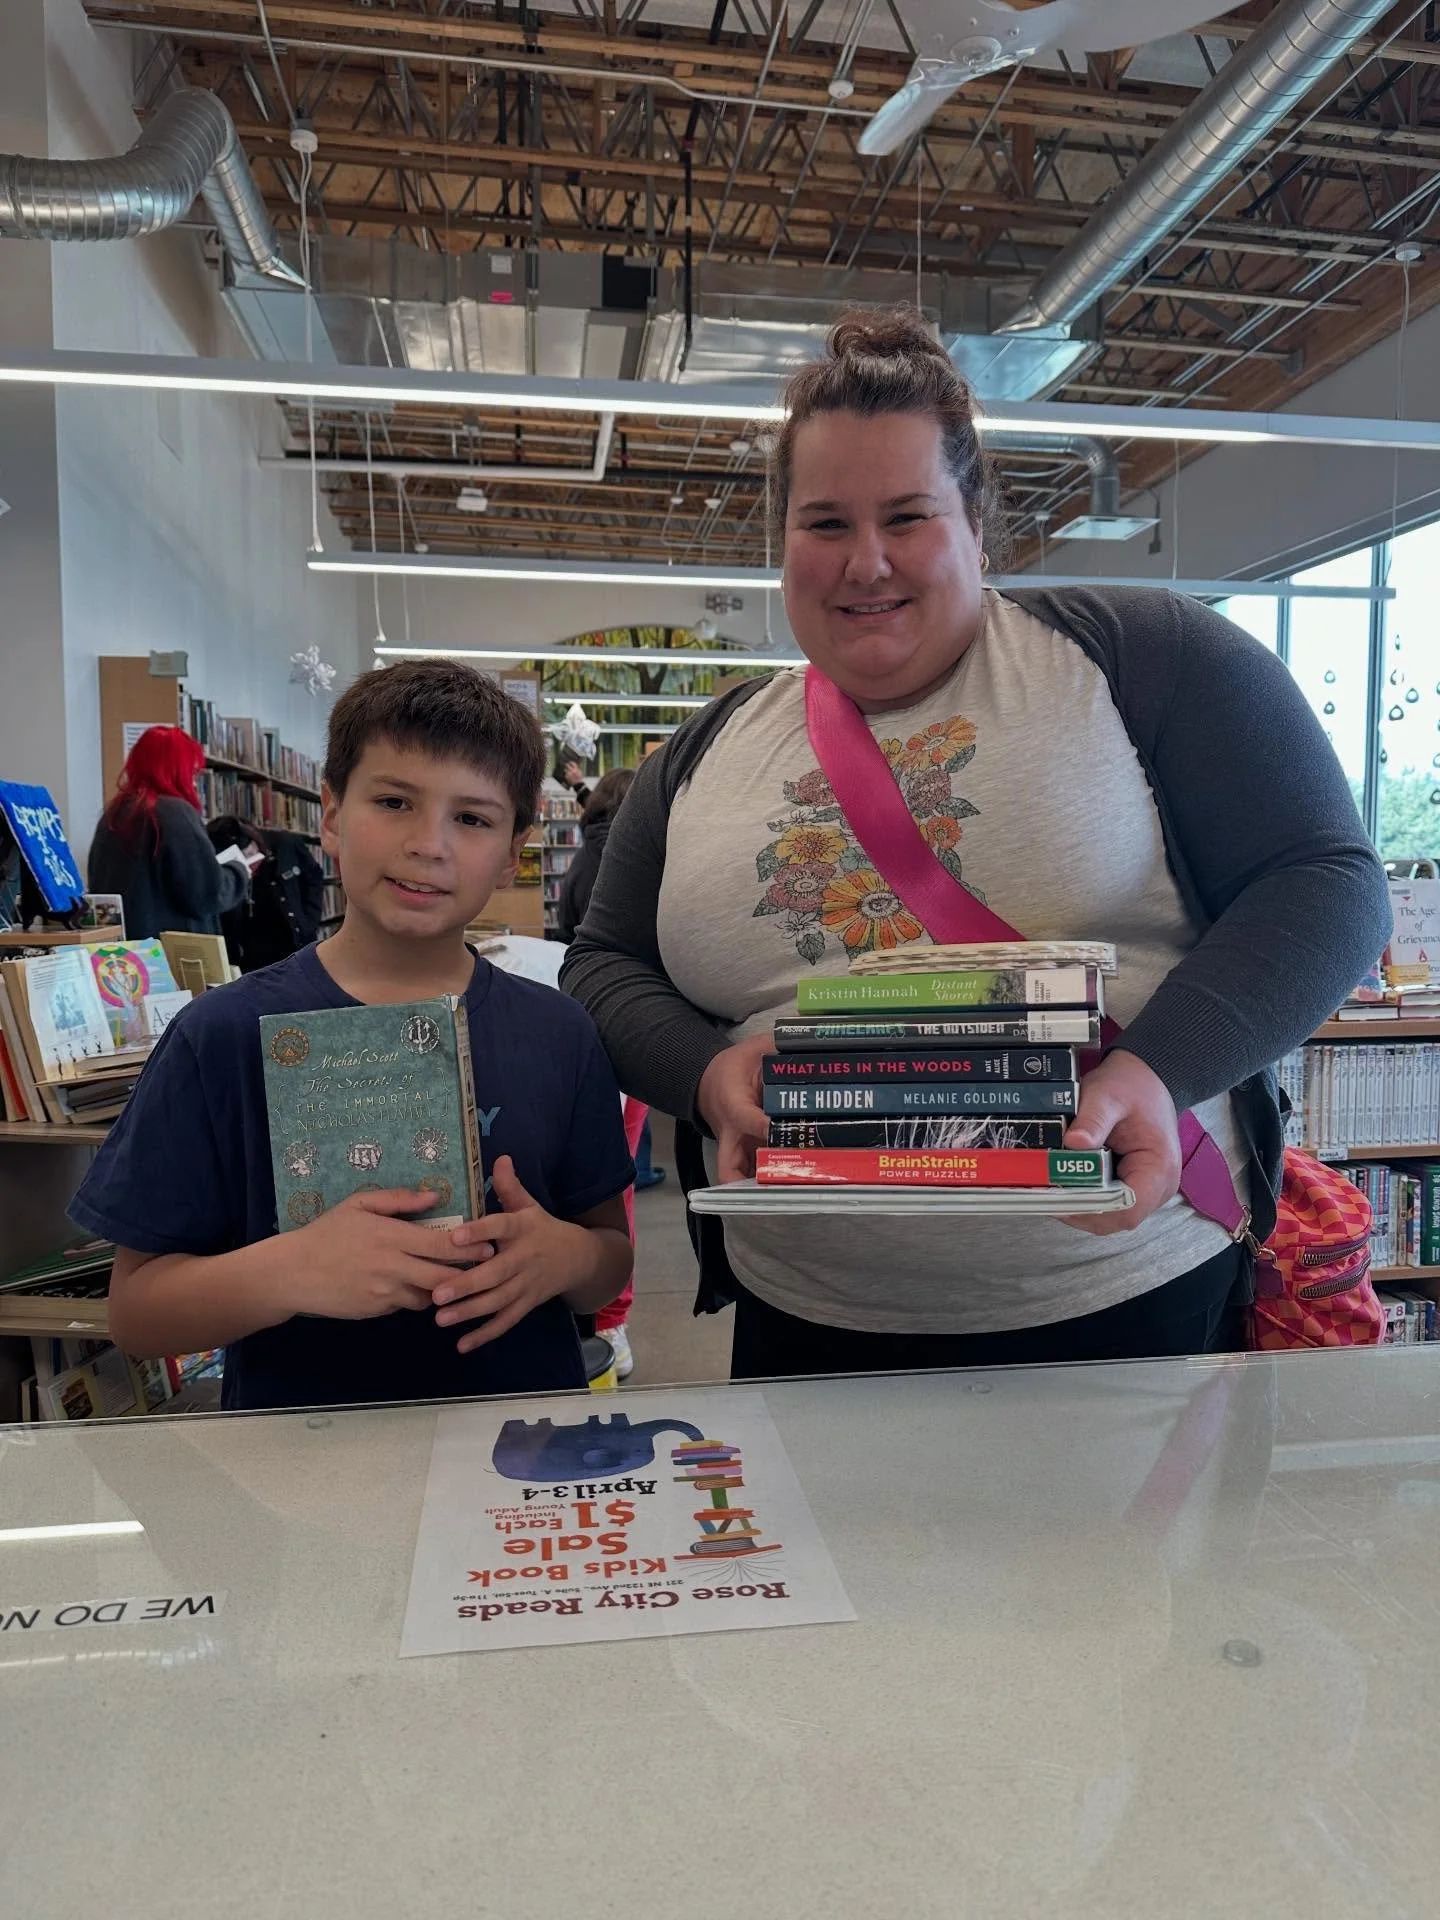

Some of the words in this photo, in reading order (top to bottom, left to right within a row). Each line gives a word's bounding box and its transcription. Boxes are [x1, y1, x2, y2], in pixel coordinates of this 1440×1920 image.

[1399, 907, 1416, 916] The
[1419, 907, 1436, 918] Age
[1414, 920, 1425, 932] of
[1398, 935, 1440, 944] Grievanc
[808, 988, 857, 1000] Kristin
[861, 985, 918, 999] Hannah
[930, 979, 977, 990] Distant
[934, 989, 974, 1001] Shores
[815, 1022, 905, 1039] MINECRAFT
[917, 1023, 940, 1035] THE
[312, 1049, 368, 1071] Michael
[366, 1051, 399, 1063] Scott
[772, 1063, 815, 1074] WHAT
[820, 1063, 850, 1074] LIES
[856, 1062, 871, 1073] IN
[876, 1062, 906, 1073] THE
[912, 1061, 972, 1073] WOODS
[303, 1075, 331, 1096] The
[338, 1076, 392, 1089] Secrets
[295, 1101, 327, 1114] THE
[345, 1090, 434, 1109] IMMORTAL
[778, 1090, 808, 1109] THE
[815, 1090, 874, 1109] HIDDEN
[903, 1093, 957, 1104] MELANIE
[963, 1092, 1021, 1104] GOLDING
[297, 1111, 375, 1131] NICHOLAS
[879, 1155, 978, 1168] BrainStrains
[1056, 1160, 1095, 1172] USED
[879, 1170, 920, 1178] POWER
[924, 1170, 977, 1178] PUZZLES
[521, 1485, 569, 1501] 3-4
[575, 1477, 658, 1499] April
[484, 1507, 520, 1515] Adult
[495, 1511, 556, 1520] Including
[524, 1503, 566, 1511] Young
[571, 1498, 636, 1529] $1
[495, 1518, 563, 1534] Each
[503, 1532, 629, 1561] Sale
[467, 1564, 568, 1587] Book
[583, 1557, 667, 1578] Kids
[613, 1582, 643, 1590] 122nd
[691, 1582, 790, 1600] Rose
[140, 1595, 215, 1620] WE
[594, 1590, 680, 1610] City
[55, 1602, 128, 1626] DO
[457, 1598, 583, 1621] Reads
[0, 1609, 40, 1632] N
